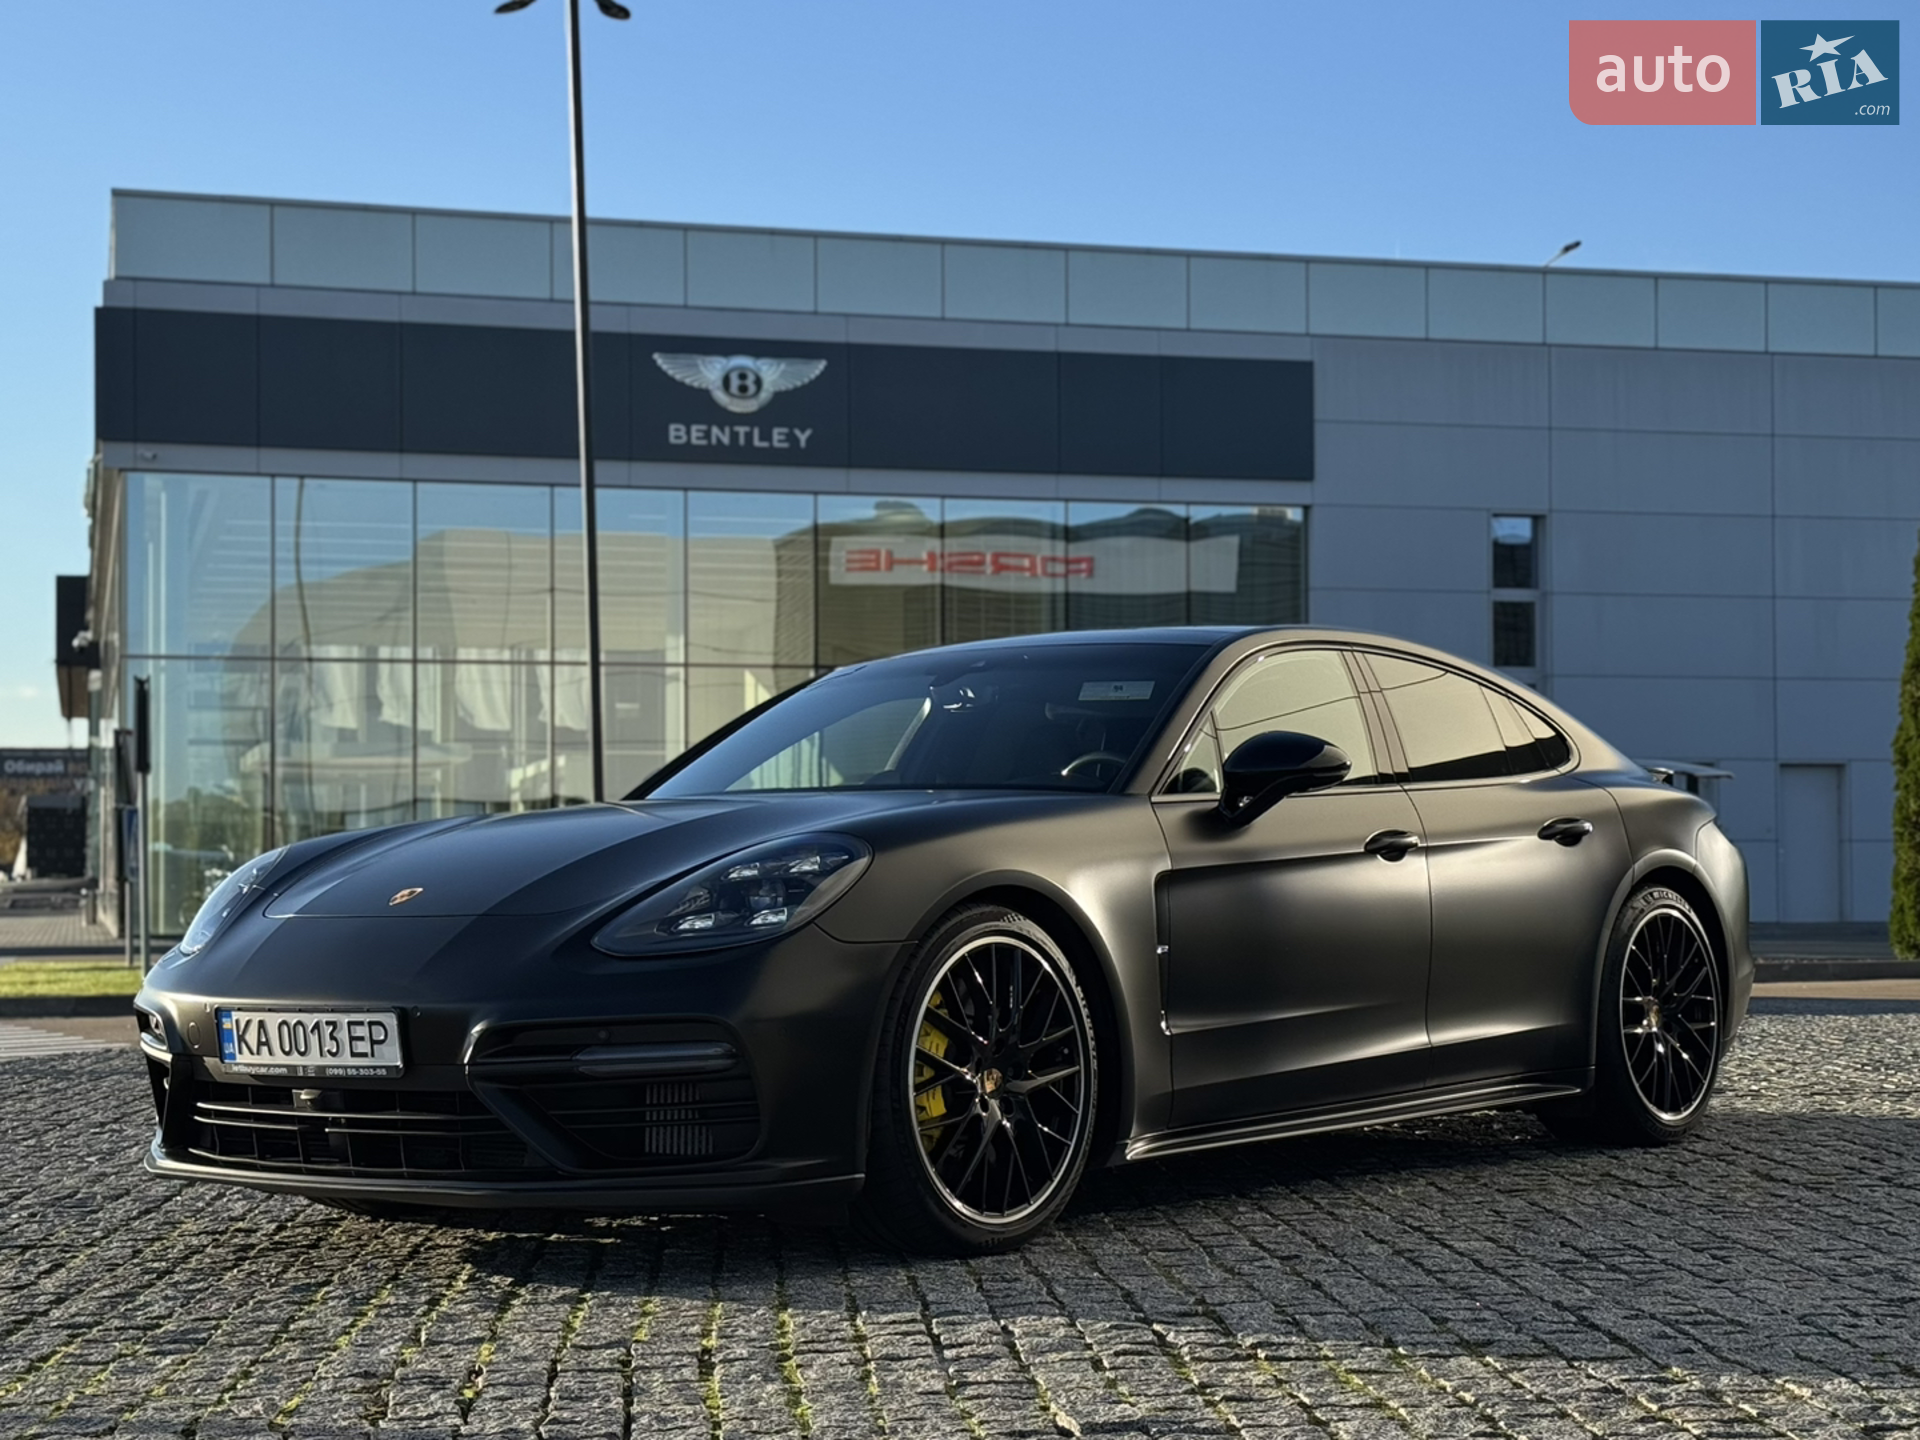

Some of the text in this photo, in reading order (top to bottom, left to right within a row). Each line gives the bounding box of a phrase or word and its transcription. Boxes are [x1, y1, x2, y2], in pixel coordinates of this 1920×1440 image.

[668, 423, 813, 449] BENTLEY
[235, 1019, 389, 1058] KA 0013 EP
